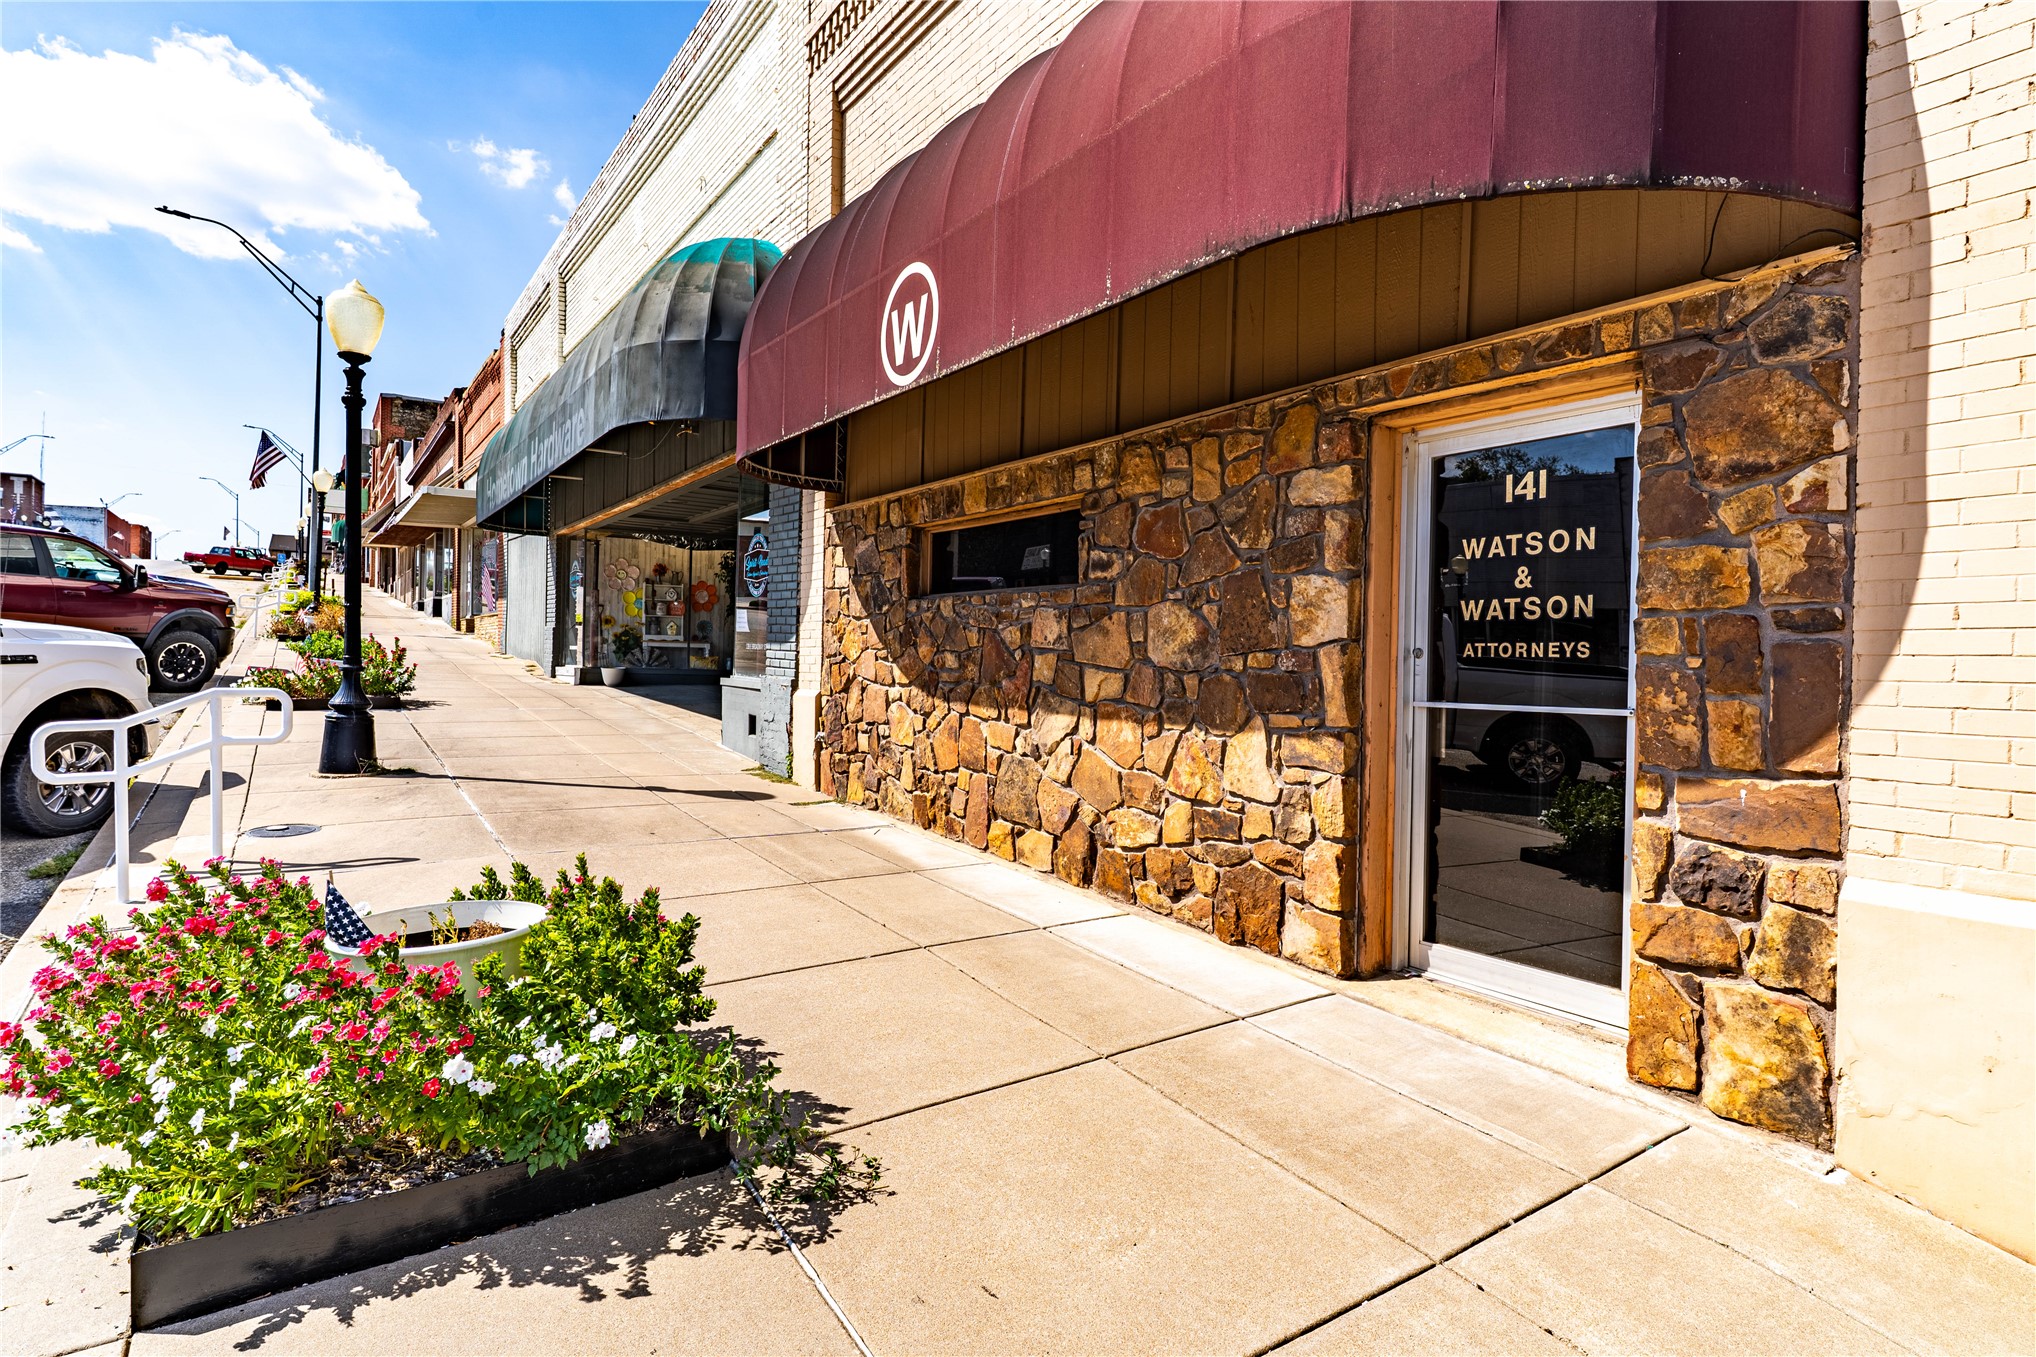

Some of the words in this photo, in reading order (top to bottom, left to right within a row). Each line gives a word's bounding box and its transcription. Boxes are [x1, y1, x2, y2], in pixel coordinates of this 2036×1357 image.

[891, 292, 928, 367] W
[486, 456, 528, 510] Hometown
[530, 408, 585, 483] Hardware
[1505, 469, 1547, 503] 141
[1461, 526, 1596, 560] WATSON
[1514, 566, 1532, 589] &
[1460, 594, 1594, 621] WATSON
[1463, 641, 1590, 659] ATTORNEYS
